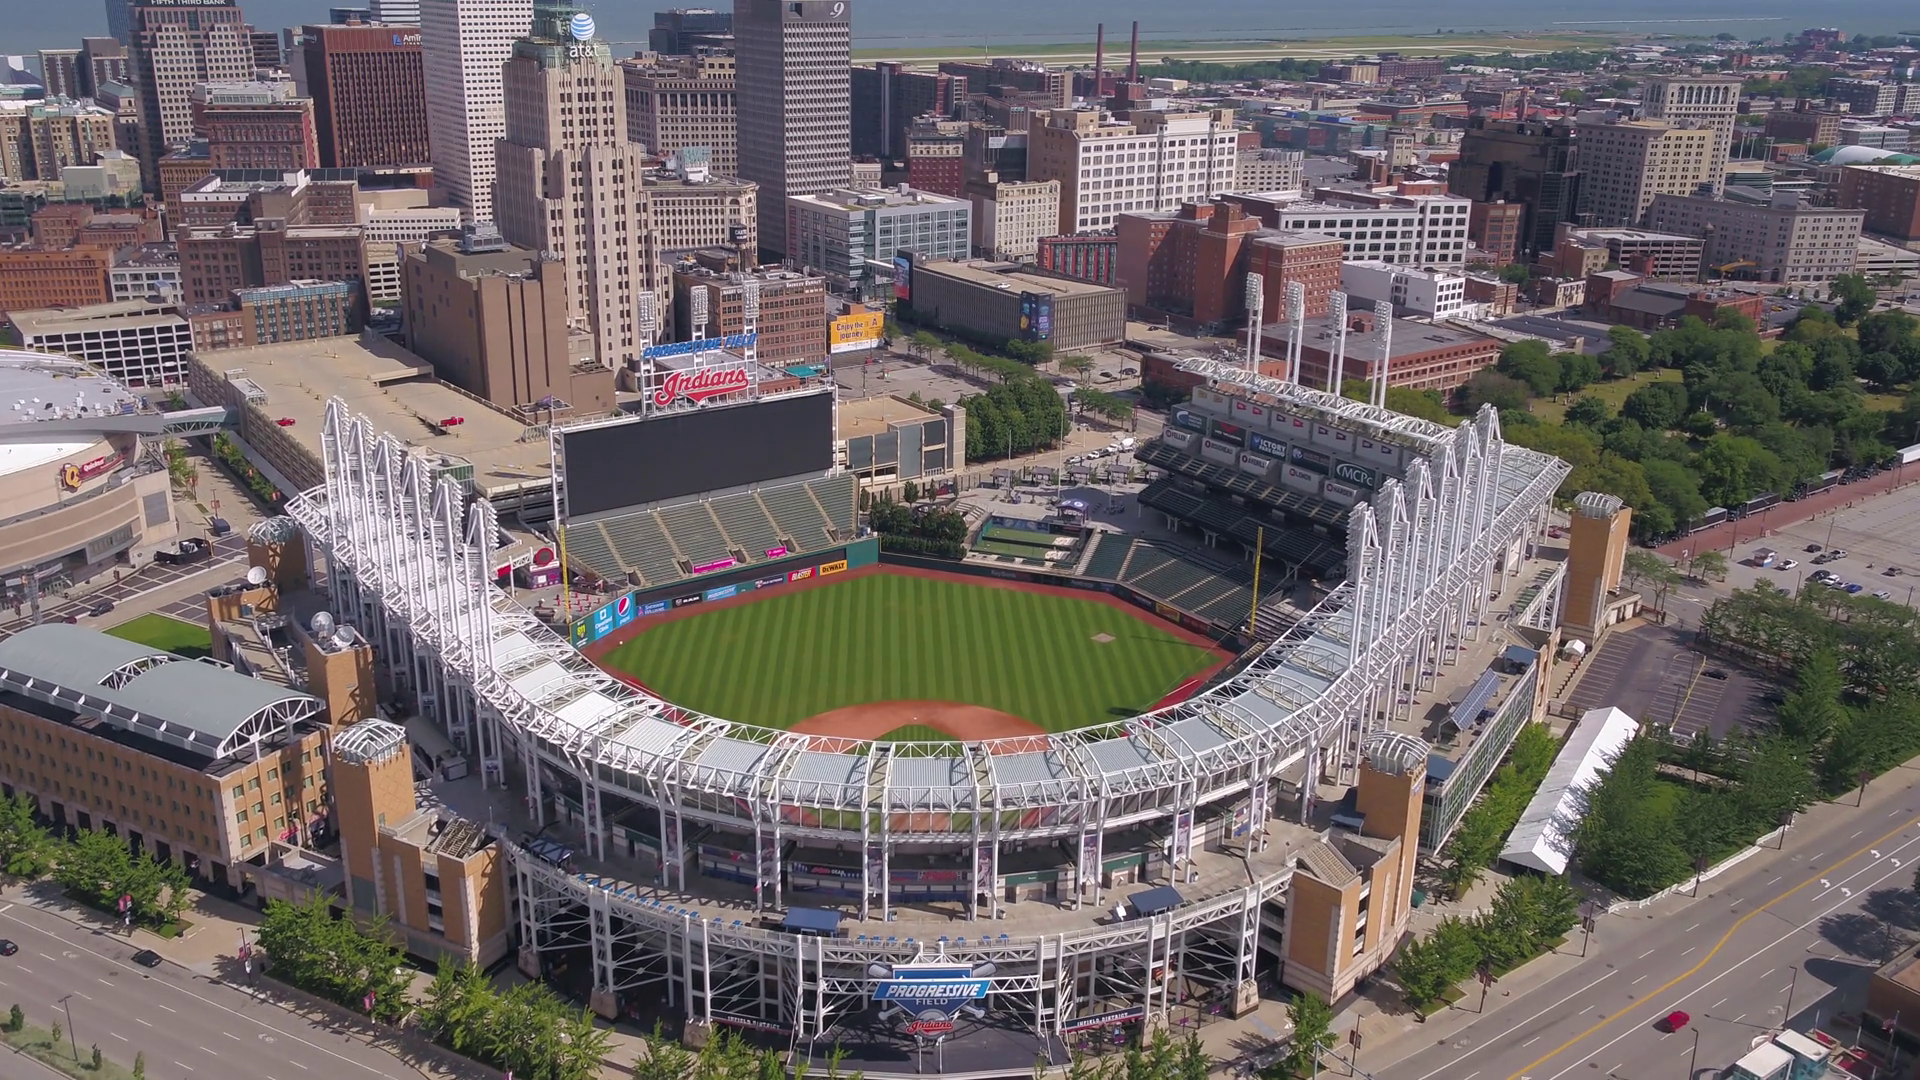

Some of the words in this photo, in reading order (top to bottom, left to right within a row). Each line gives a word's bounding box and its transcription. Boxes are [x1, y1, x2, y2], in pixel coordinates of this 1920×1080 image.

[570, 43, 599, 58] at&t
[836, 323, 854, 331] Enjoy
[854, 321, 864, 329] the
[840, 331, 864, 341] journey
[643, 337, 722, 358] PROGRESSIVE
[724, 333, 757, 347] FIELD
[654, 367, 749, 406] Indians
[885, 983, 982, 998] PROGRESSIVE
[915, 998, 949, 1006] FIELD
[752, 1020, 781, 1030] DISTRICT
[1077, 1018, 1100, 1027] INFIELD
[1101, 1012, 1129, 1022] DISTRICT
[906, 1020, 954, 1034] Indians
